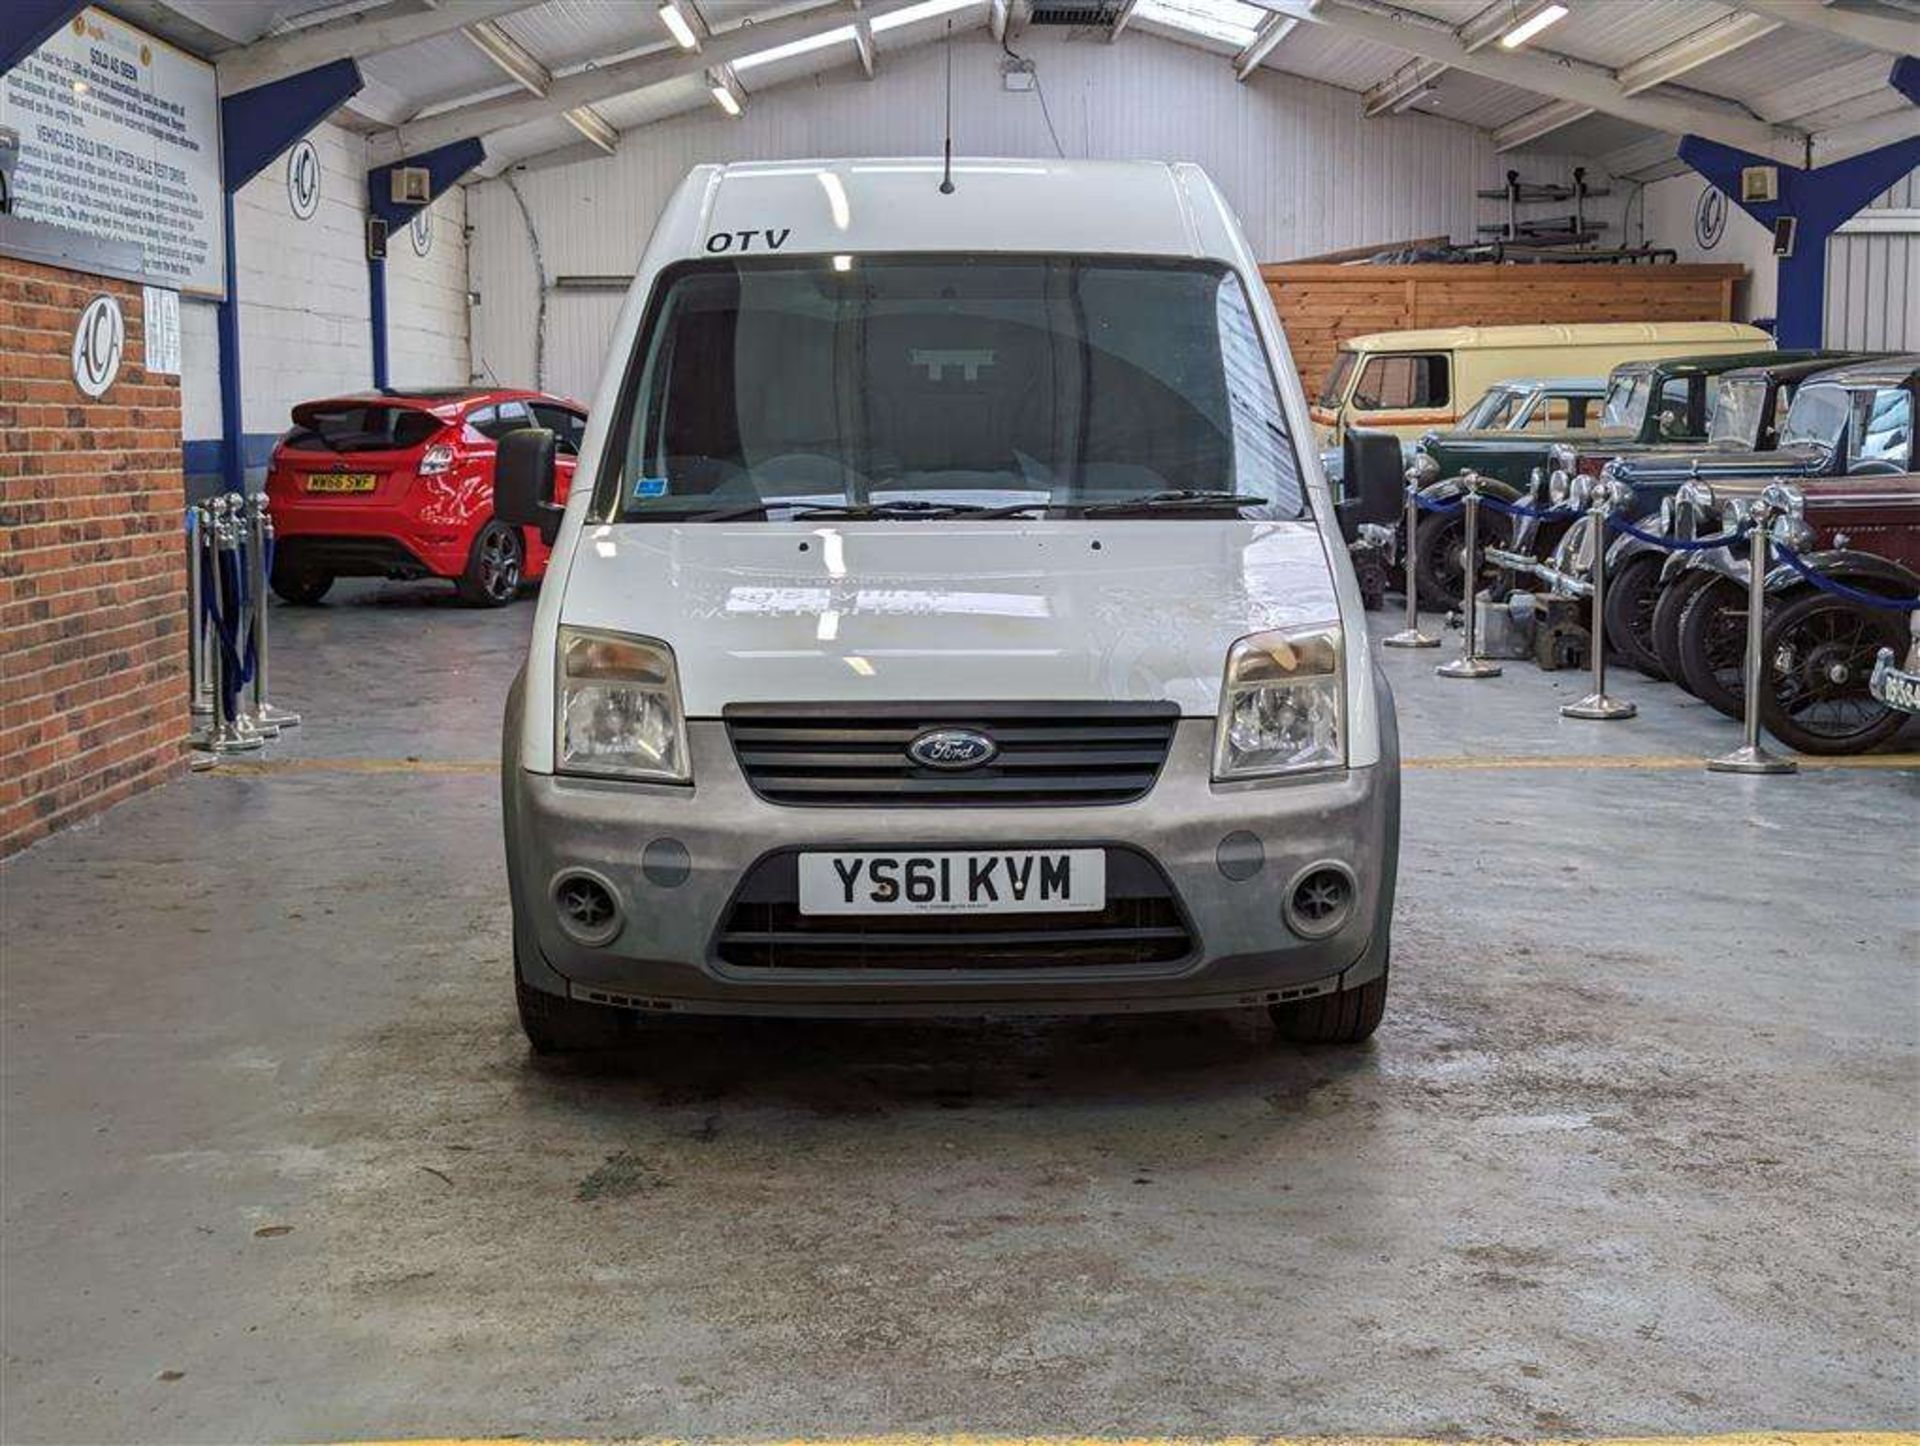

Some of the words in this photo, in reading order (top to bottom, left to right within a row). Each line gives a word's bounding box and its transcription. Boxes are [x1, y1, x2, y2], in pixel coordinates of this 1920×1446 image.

[90, 47, 107, 69] SOLD
[110, 56, 119, 74] AS
[120, 60, 137, 82] SEEN
[36, 123, 73, 150] VEHICLES
[76, 136, 94, 156] SOLD
[96, 142, 113, 162] WITH
[114, 148, 133, 168] AFTER
[136, 155, 151, 173] SALE
[153, 161, 167, 178] TEST
[706, 229, 790, 252] OTV
[930, 741, 975, 760] Ford
[833, 857, 950, 904] YS61
[968, 855, 1070, 902] KVM
